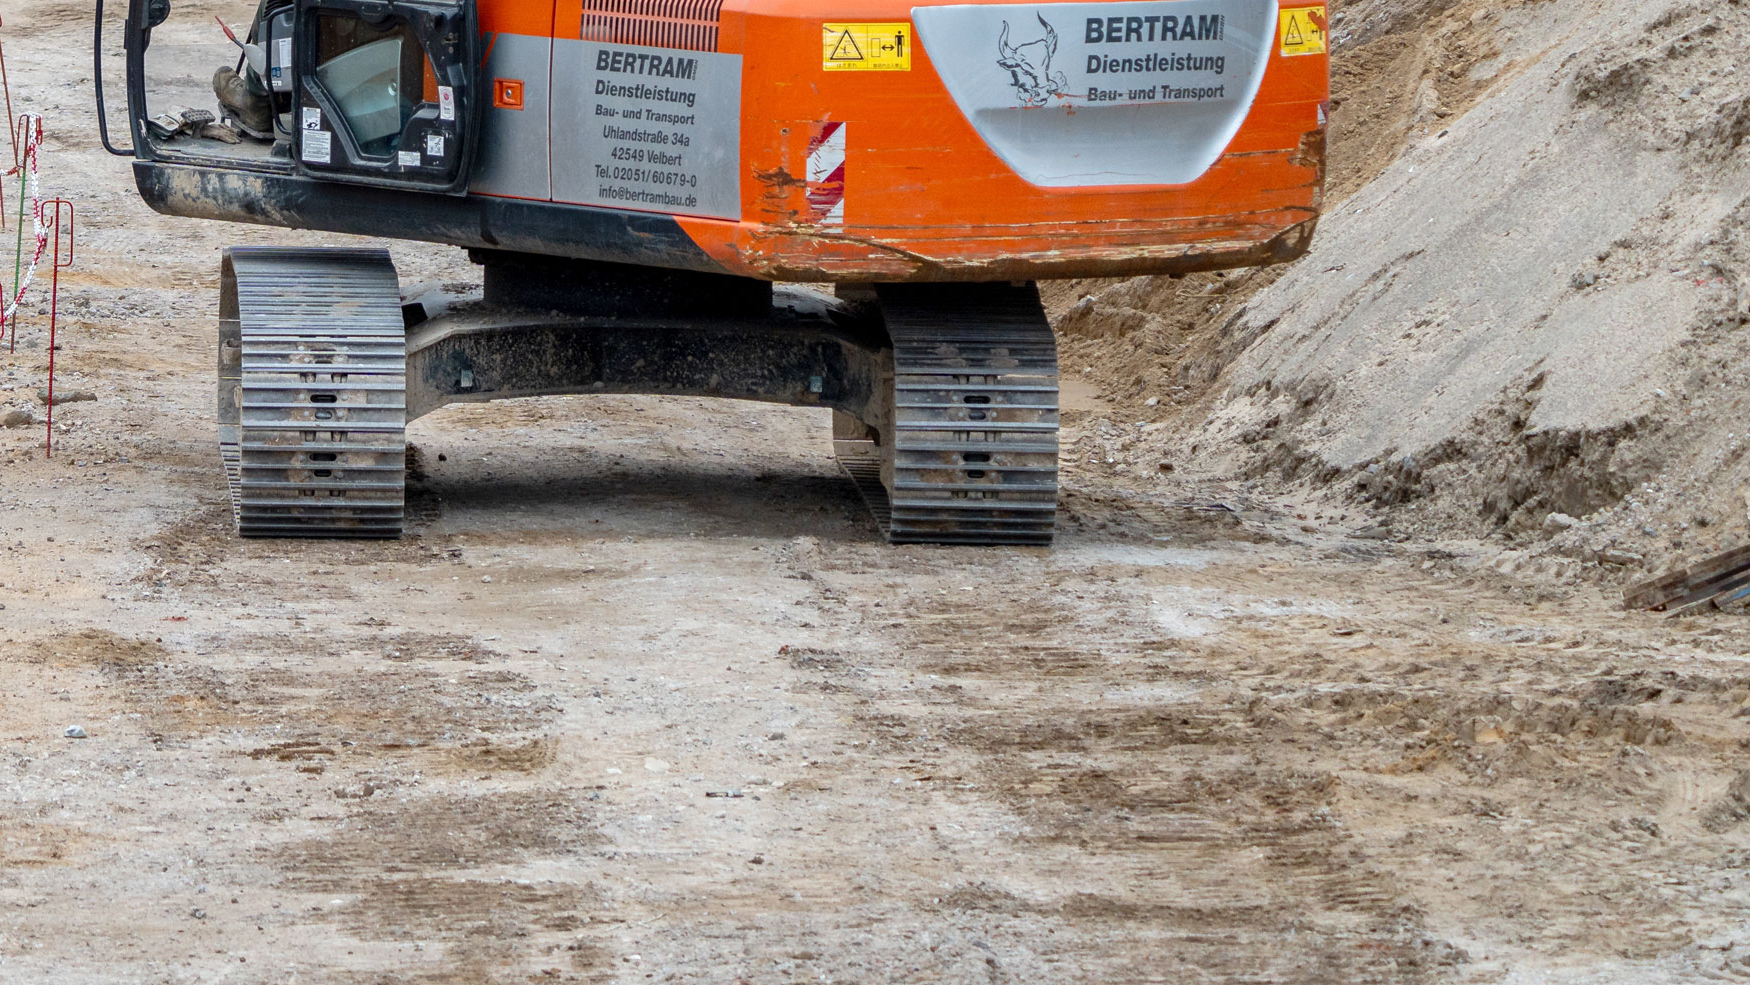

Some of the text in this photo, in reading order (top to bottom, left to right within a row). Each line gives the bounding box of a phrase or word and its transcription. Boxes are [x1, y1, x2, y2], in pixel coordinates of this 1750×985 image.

[1084, 14, 1220, 44] BERTRAM
[596, 49, 695, 80] BERTRAM
[1086, 52, 1226, 75] Dienstleistung
[594, 79, 697, 107] Dienstleistung
[1087, 85, 1225, 102] Bau- und Transport
[595, 104, 695, 125] Bau- und Transport
[602, 125, 690, 147] Uhlandstraße 34a
[611, 147, 682, 167] 42549 Velbert
[598, 185, 697, 208] info@bertrambau.de
